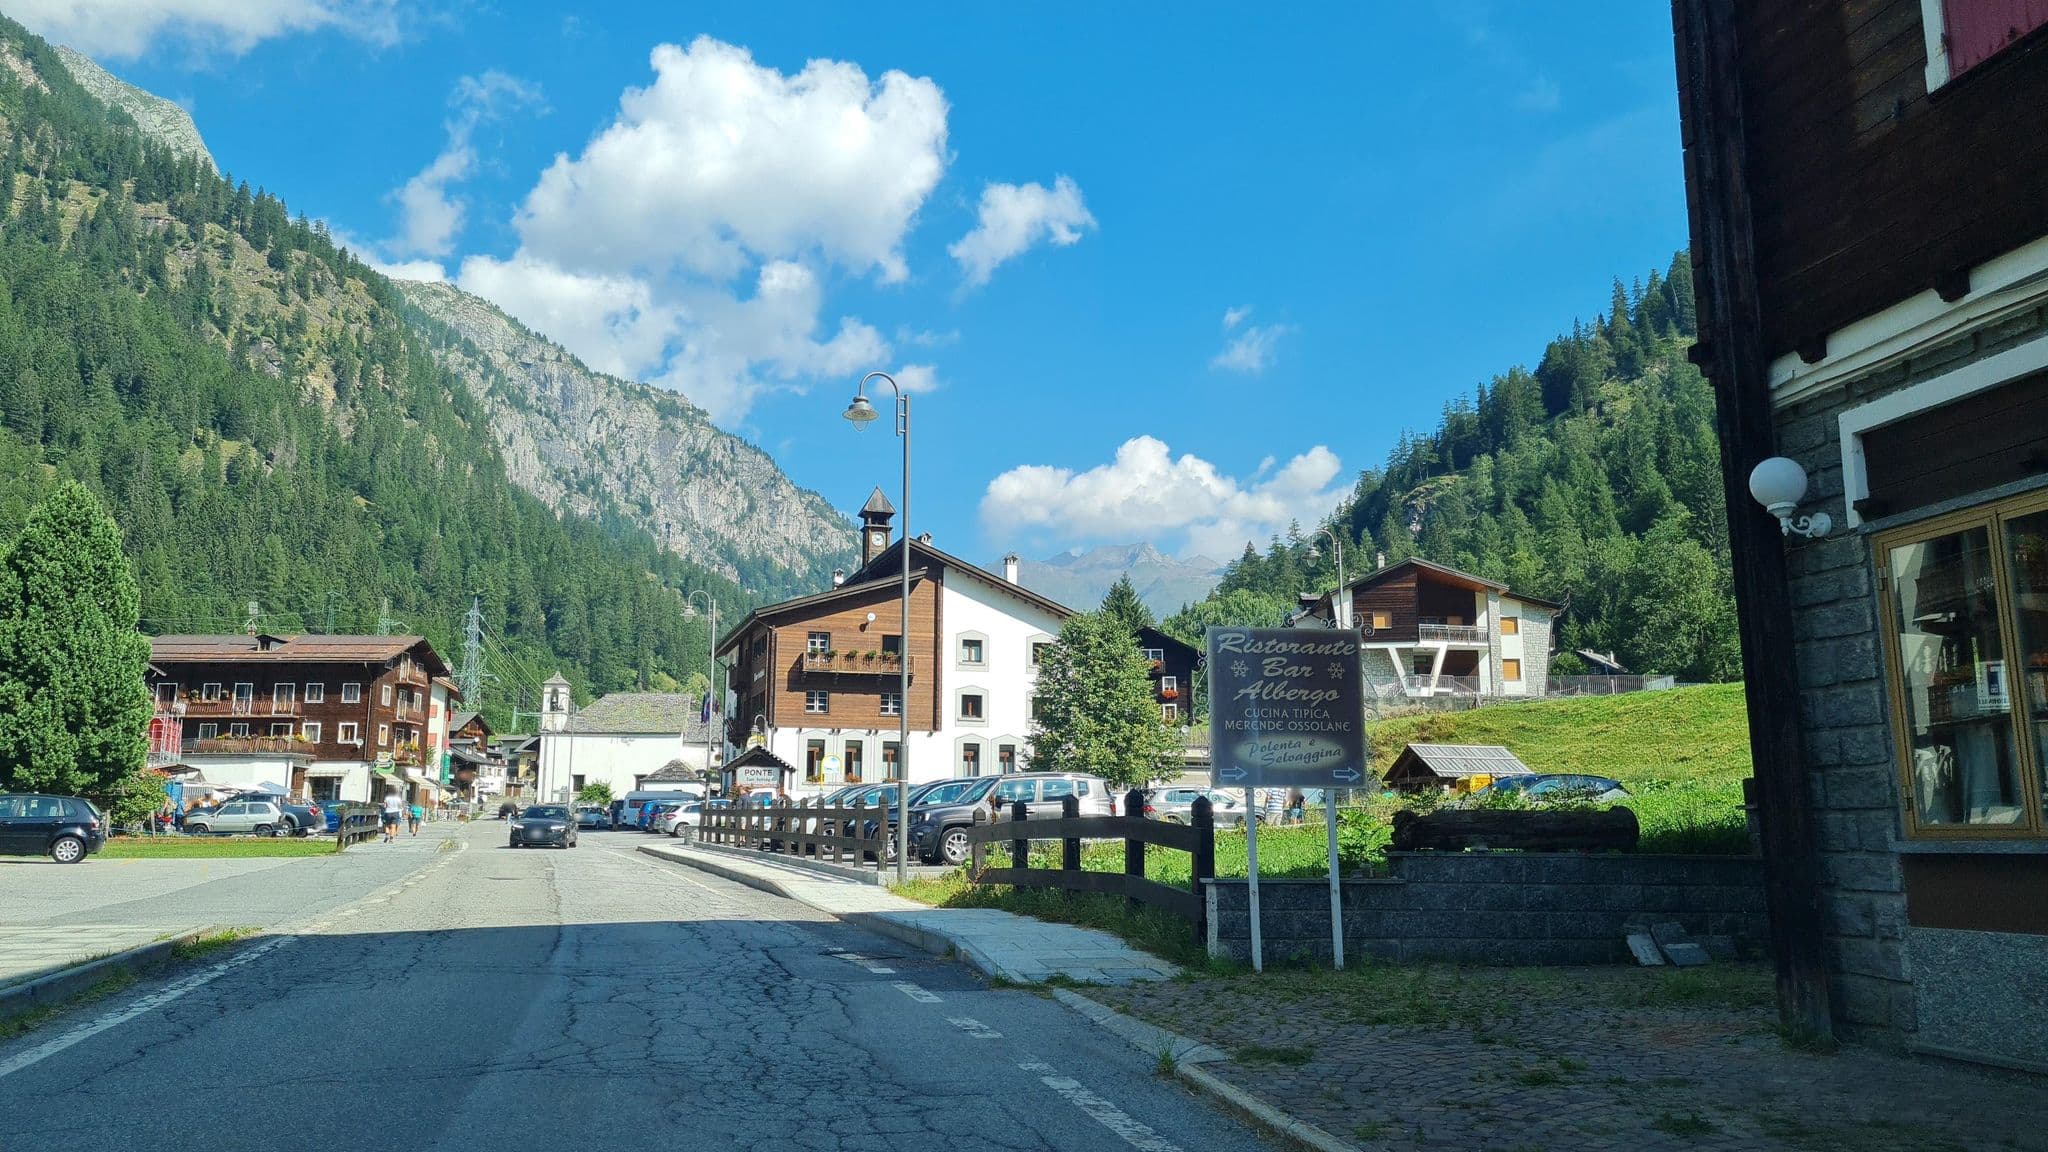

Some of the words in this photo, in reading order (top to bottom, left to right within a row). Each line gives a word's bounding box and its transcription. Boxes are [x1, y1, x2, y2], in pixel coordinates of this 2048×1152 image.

[1217, 632, 1357, 656] Ristorante
[1262, 657, 1314, 677] Bar
[1233, 680, 1341, 707] Albergo
[1244, 708, 1289, 718] CUCINA
[1293, 708, 1330, 719] TIPICA
[1224, 720, 1285, 731] MERENDE
[1288, 721, 1352, 732] OSSOLANE
[1246, 740, 1302, 758] Polenta
[1261, 748, 1342, 767] Selvaggina
